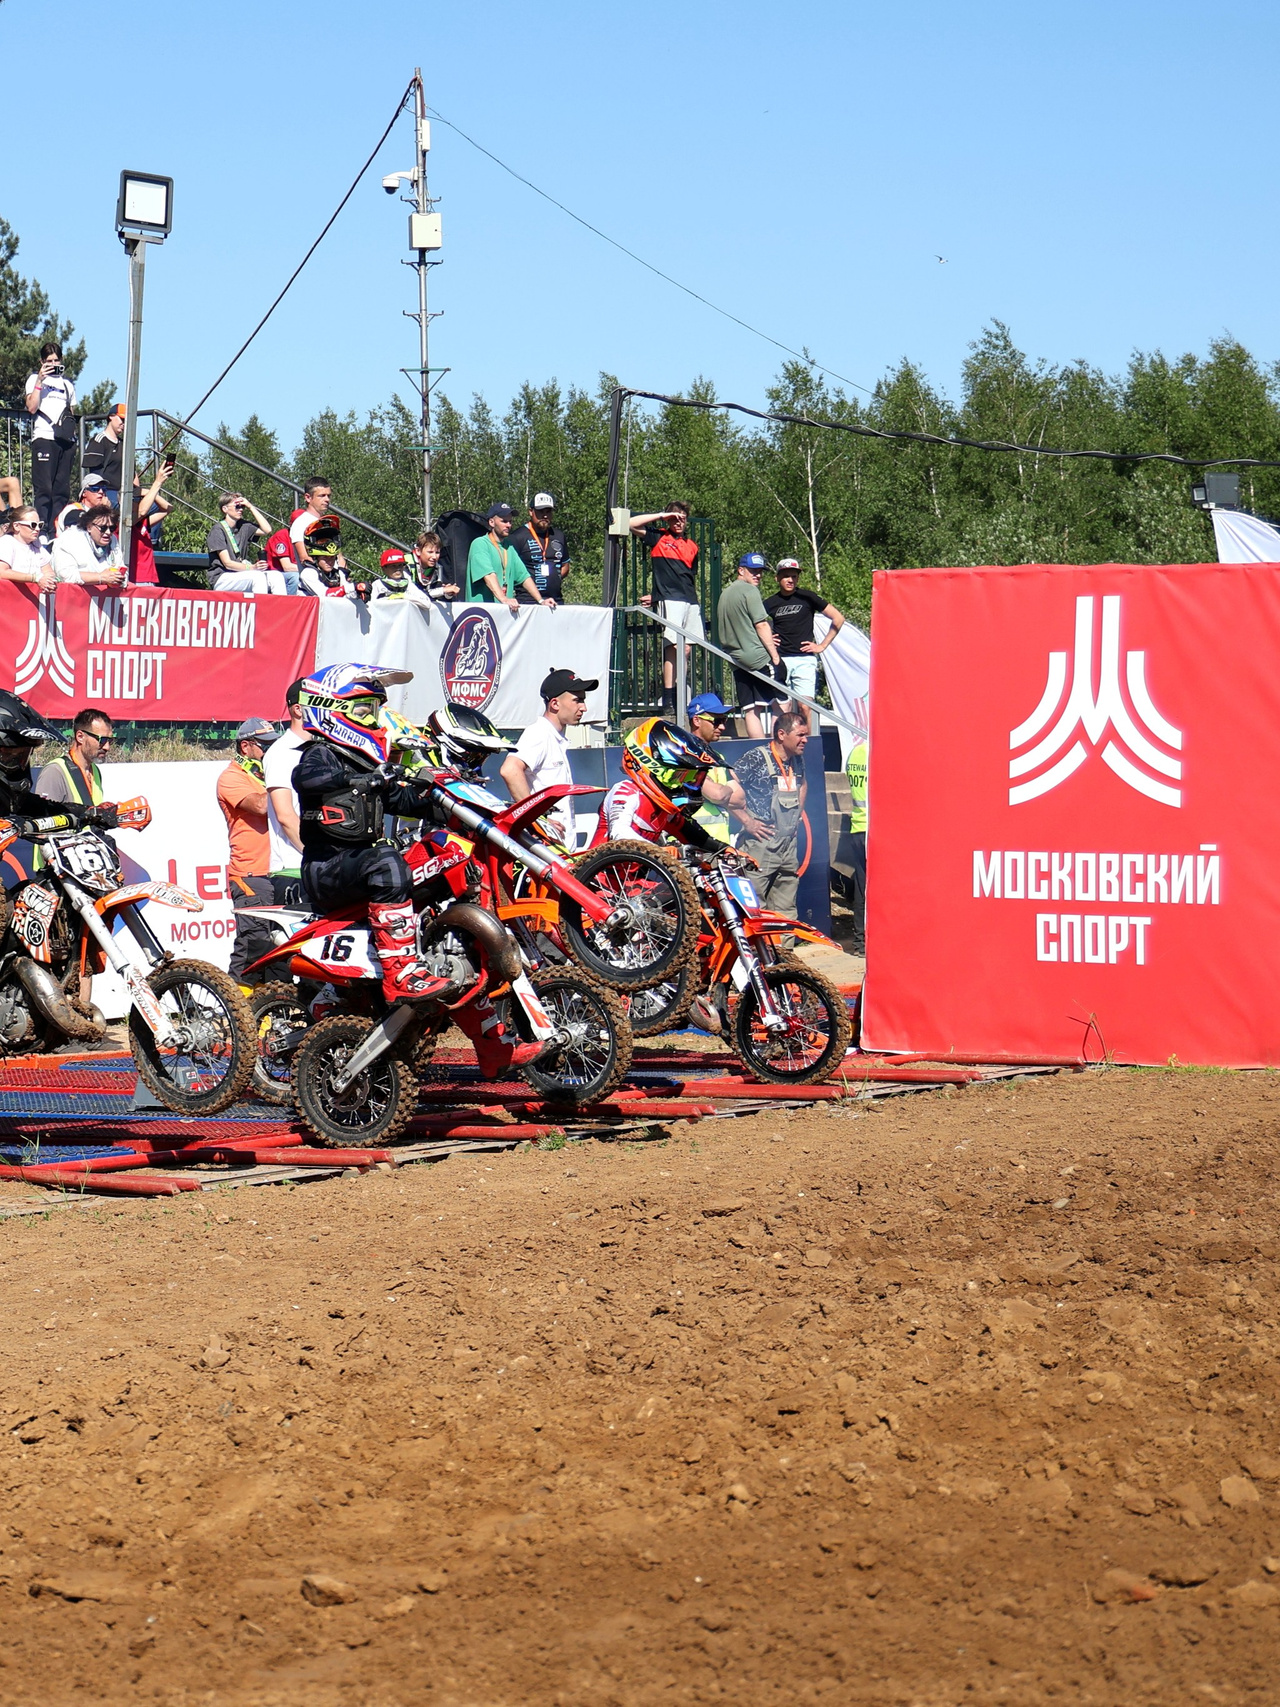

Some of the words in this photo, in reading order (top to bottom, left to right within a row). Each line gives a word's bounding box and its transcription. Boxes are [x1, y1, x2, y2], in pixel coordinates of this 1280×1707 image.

[88, 592, 256, 649] МОСКОВСКИЙ
[87, 650, 167, 699] СПОРТ
[451, 682, 486, 697] МФМС
[308, 694, 350, 711] 100%
[628, 743, 661, 774] 100%
[458, 784, 498, 805] 16
[62, 843, 114, 876] 161
[972, 843, 1220, 905] МОСКОВСКИЙ
[739, 880, 757, 908] 9
[320, 935, 355, 961] 16
[1036, 913, 1152, 966] СПОРТ
